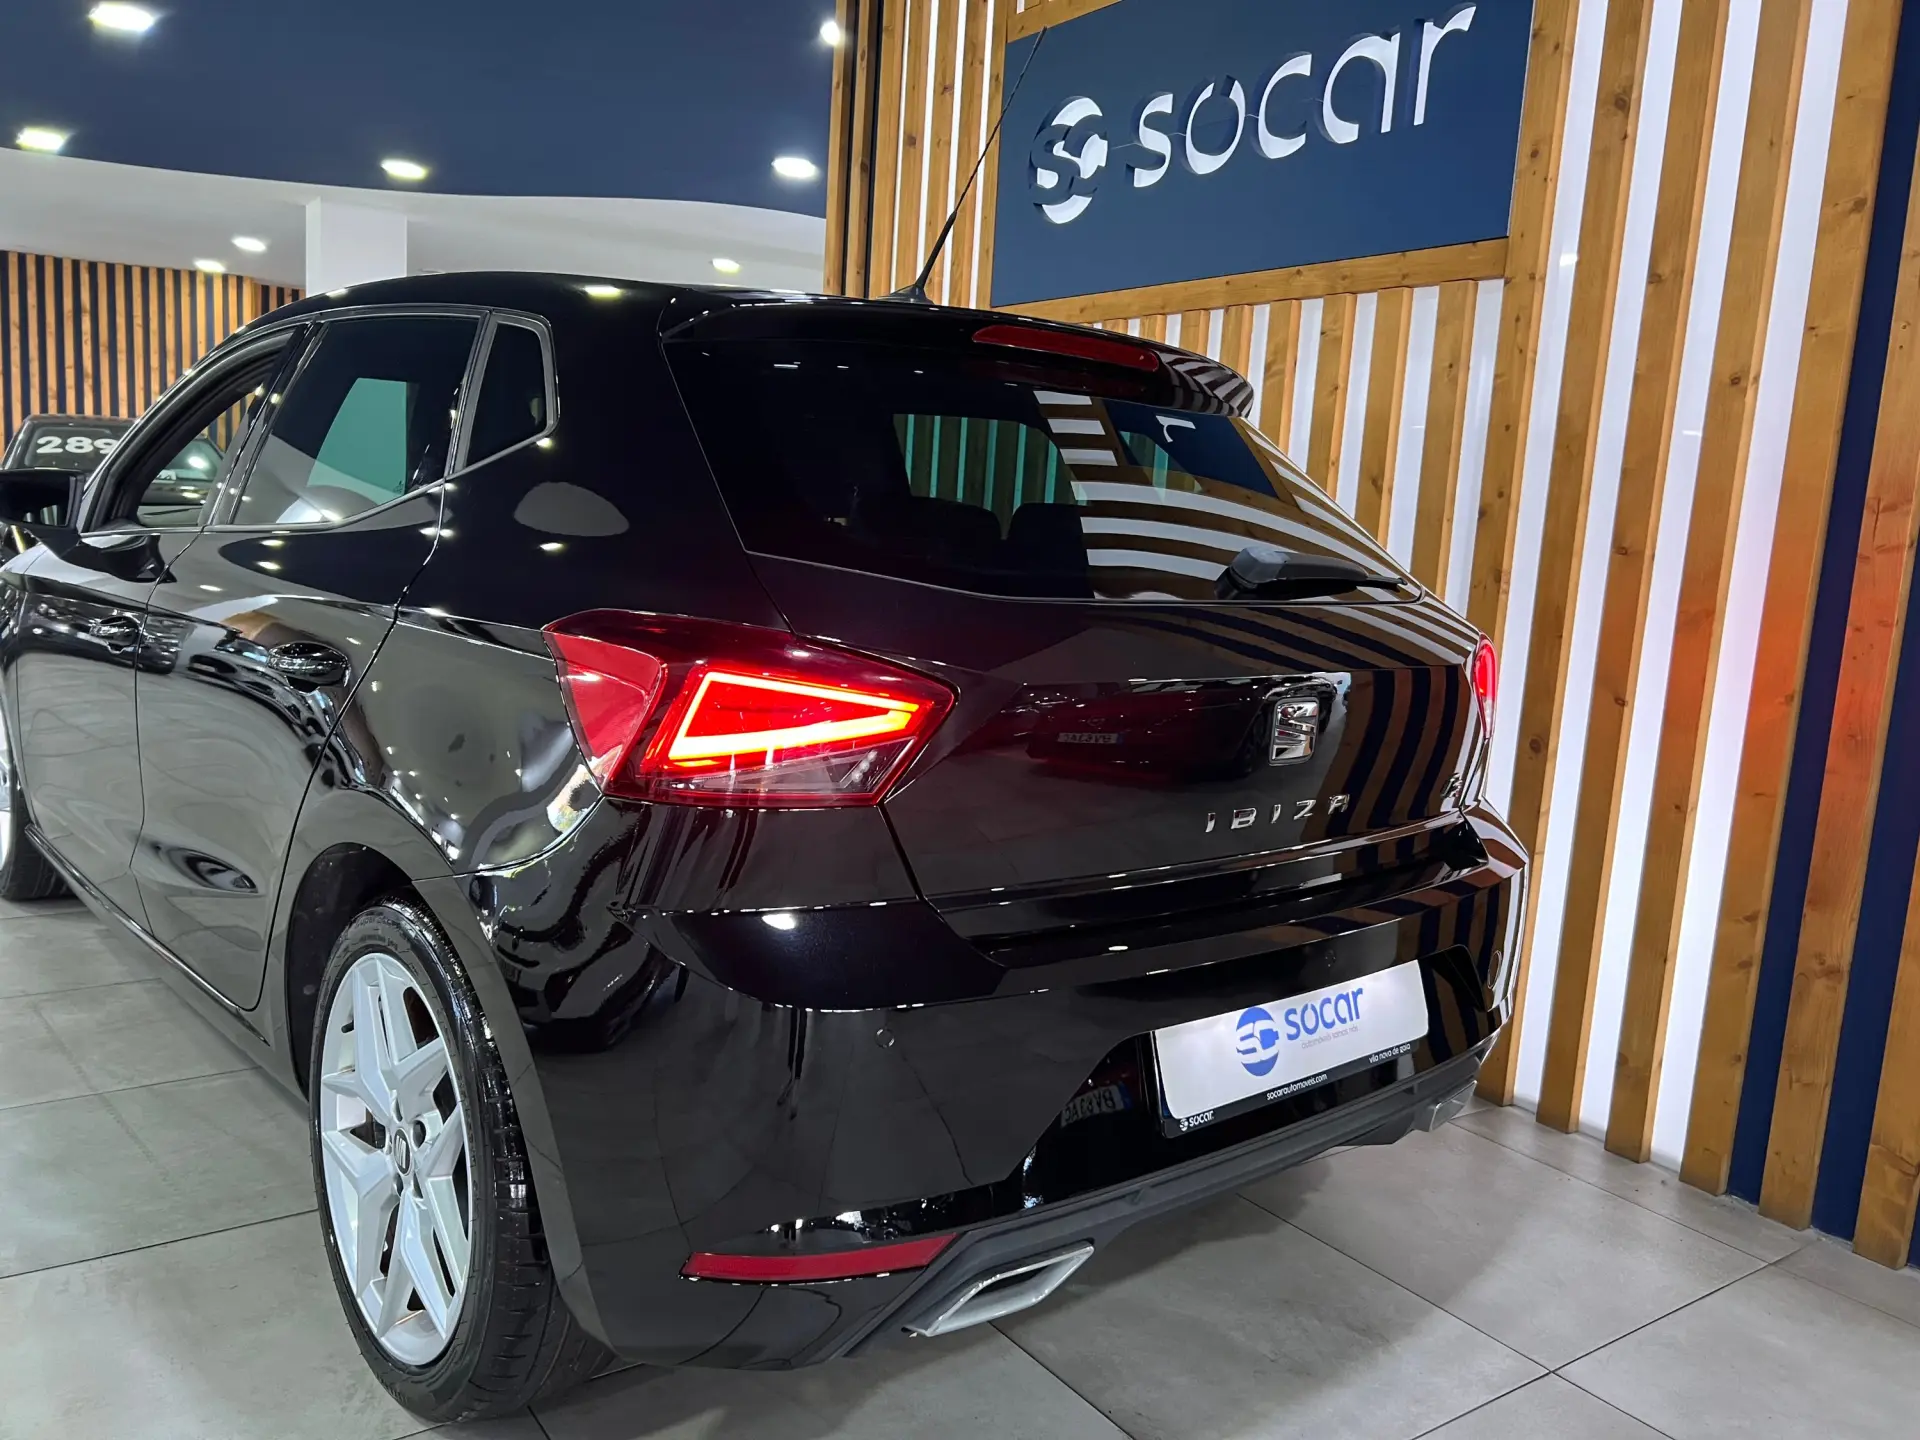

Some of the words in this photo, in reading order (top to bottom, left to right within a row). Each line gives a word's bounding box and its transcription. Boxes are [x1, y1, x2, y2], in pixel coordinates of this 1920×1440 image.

[1125, 3, 1476, 188] socar
[1205, 794, 1350, 832] IBIZA
[1284, 987, 1363, 1041] socar
[1266, 1073, 1328, 1101] socarautomoveis.com
[1189, 1110, 1214, 1127] socar
